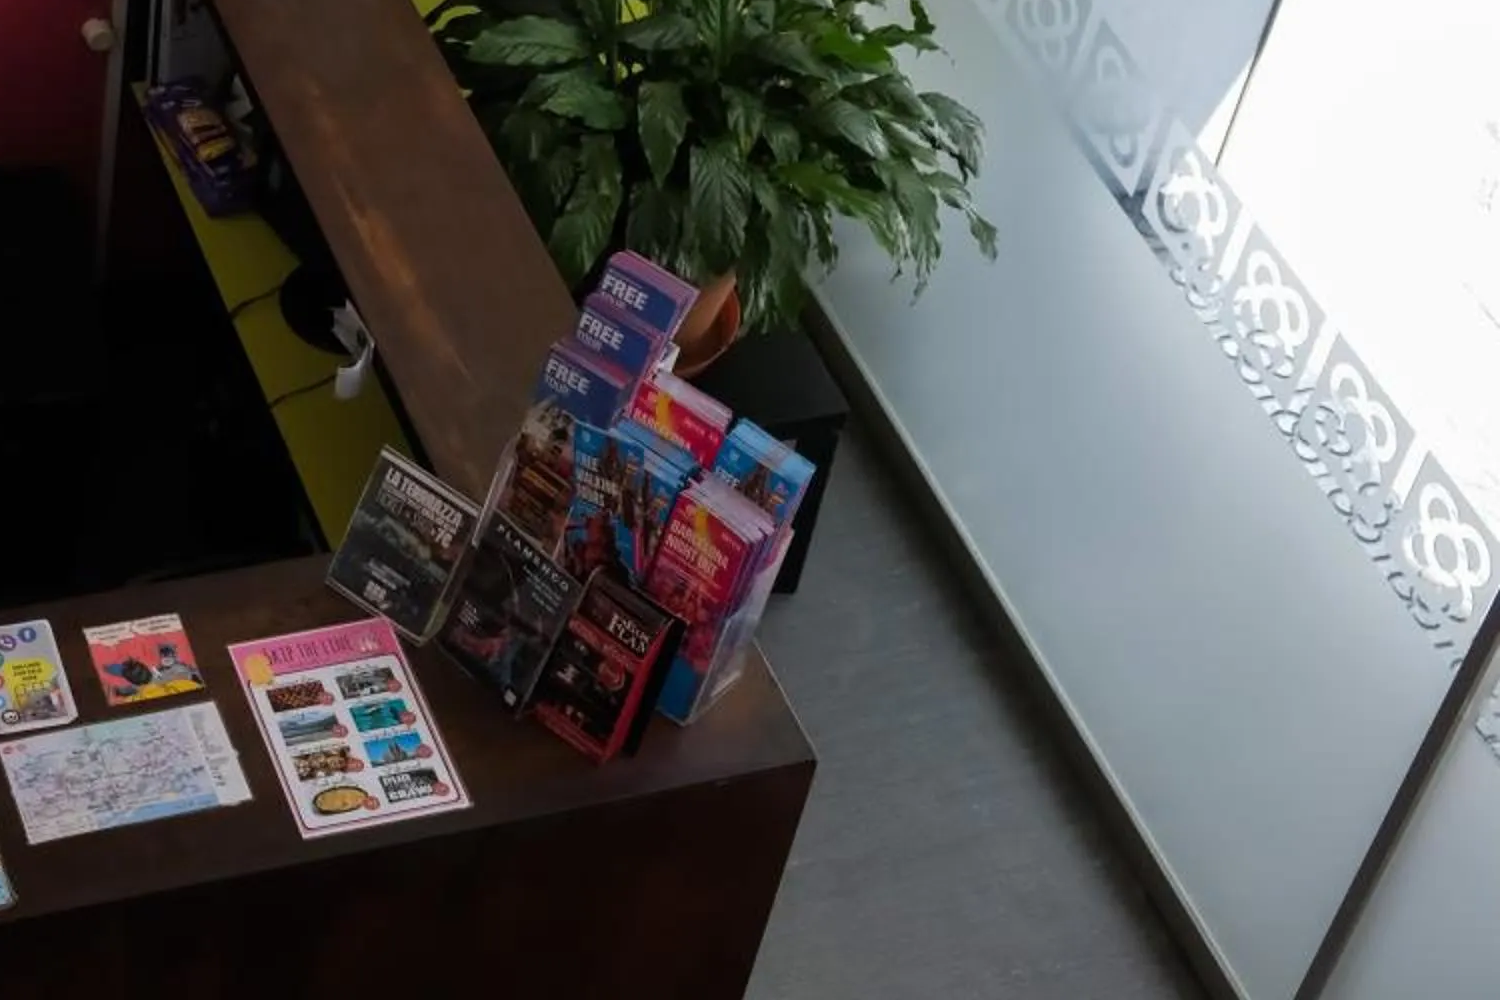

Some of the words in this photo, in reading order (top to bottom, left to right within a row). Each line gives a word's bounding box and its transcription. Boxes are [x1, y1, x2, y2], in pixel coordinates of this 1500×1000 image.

[601, 274, 649, 311] FREE
[579, 311, 625, 350] FREE
[546, 358, 591, 395] FREE
